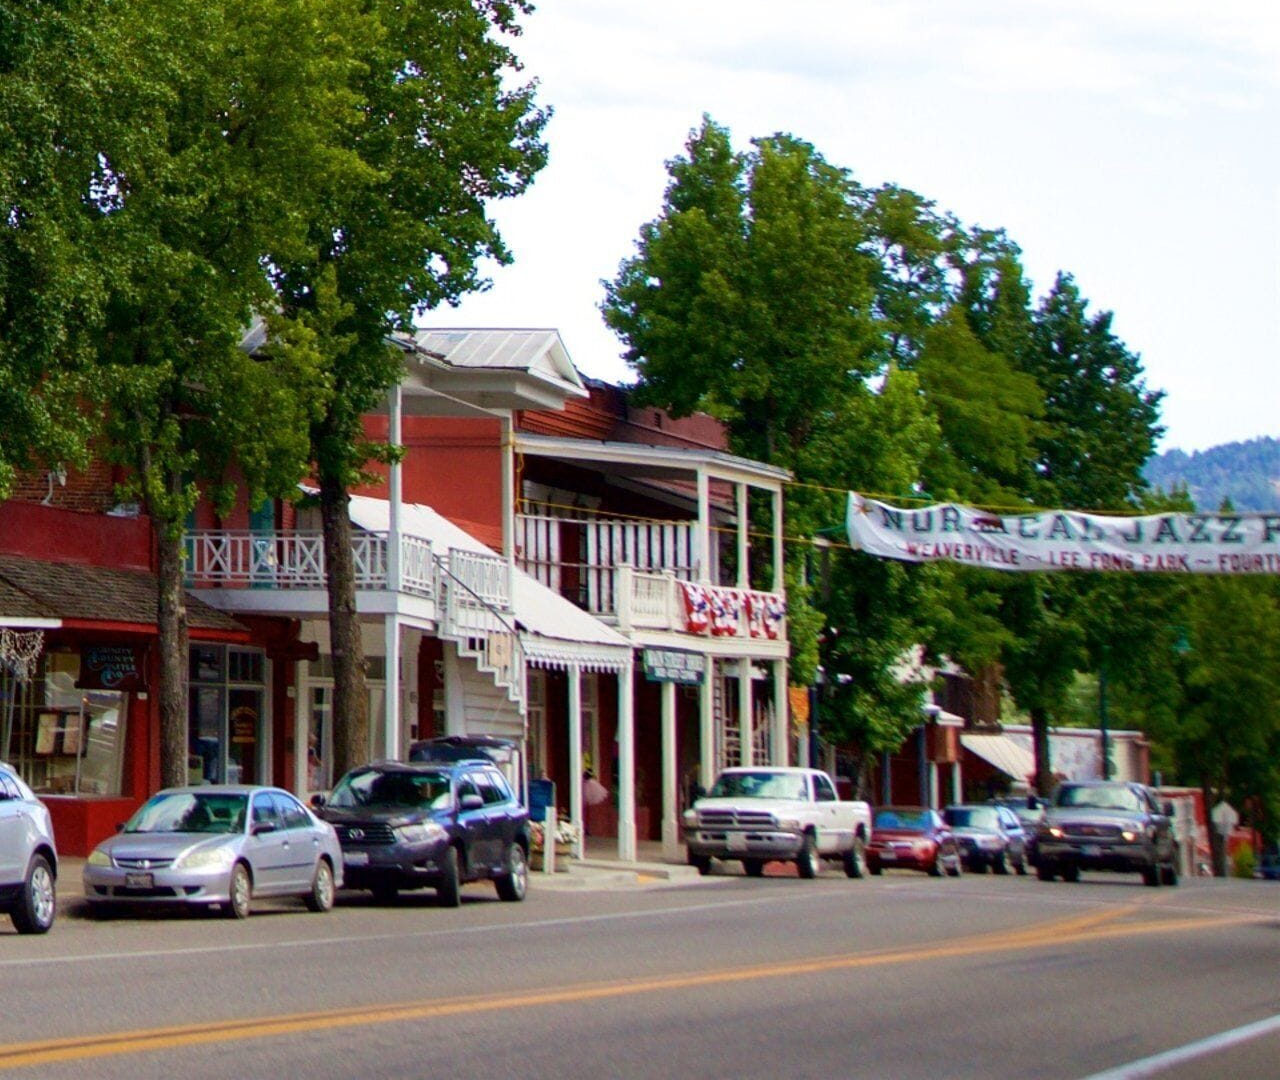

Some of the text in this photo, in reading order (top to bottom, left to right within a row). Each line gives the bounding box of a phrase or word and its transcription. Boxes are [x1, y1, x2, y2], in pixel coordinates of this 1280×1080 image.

[880, 505, 963, 533] NOR
[1122, 516, 1243, 543] JAZZ
[906, 541, 1021, 565] WEAVERVILLE
[1049, 551, 1081, 567] LEE
[1143, 554, 1190, 570] PARK
